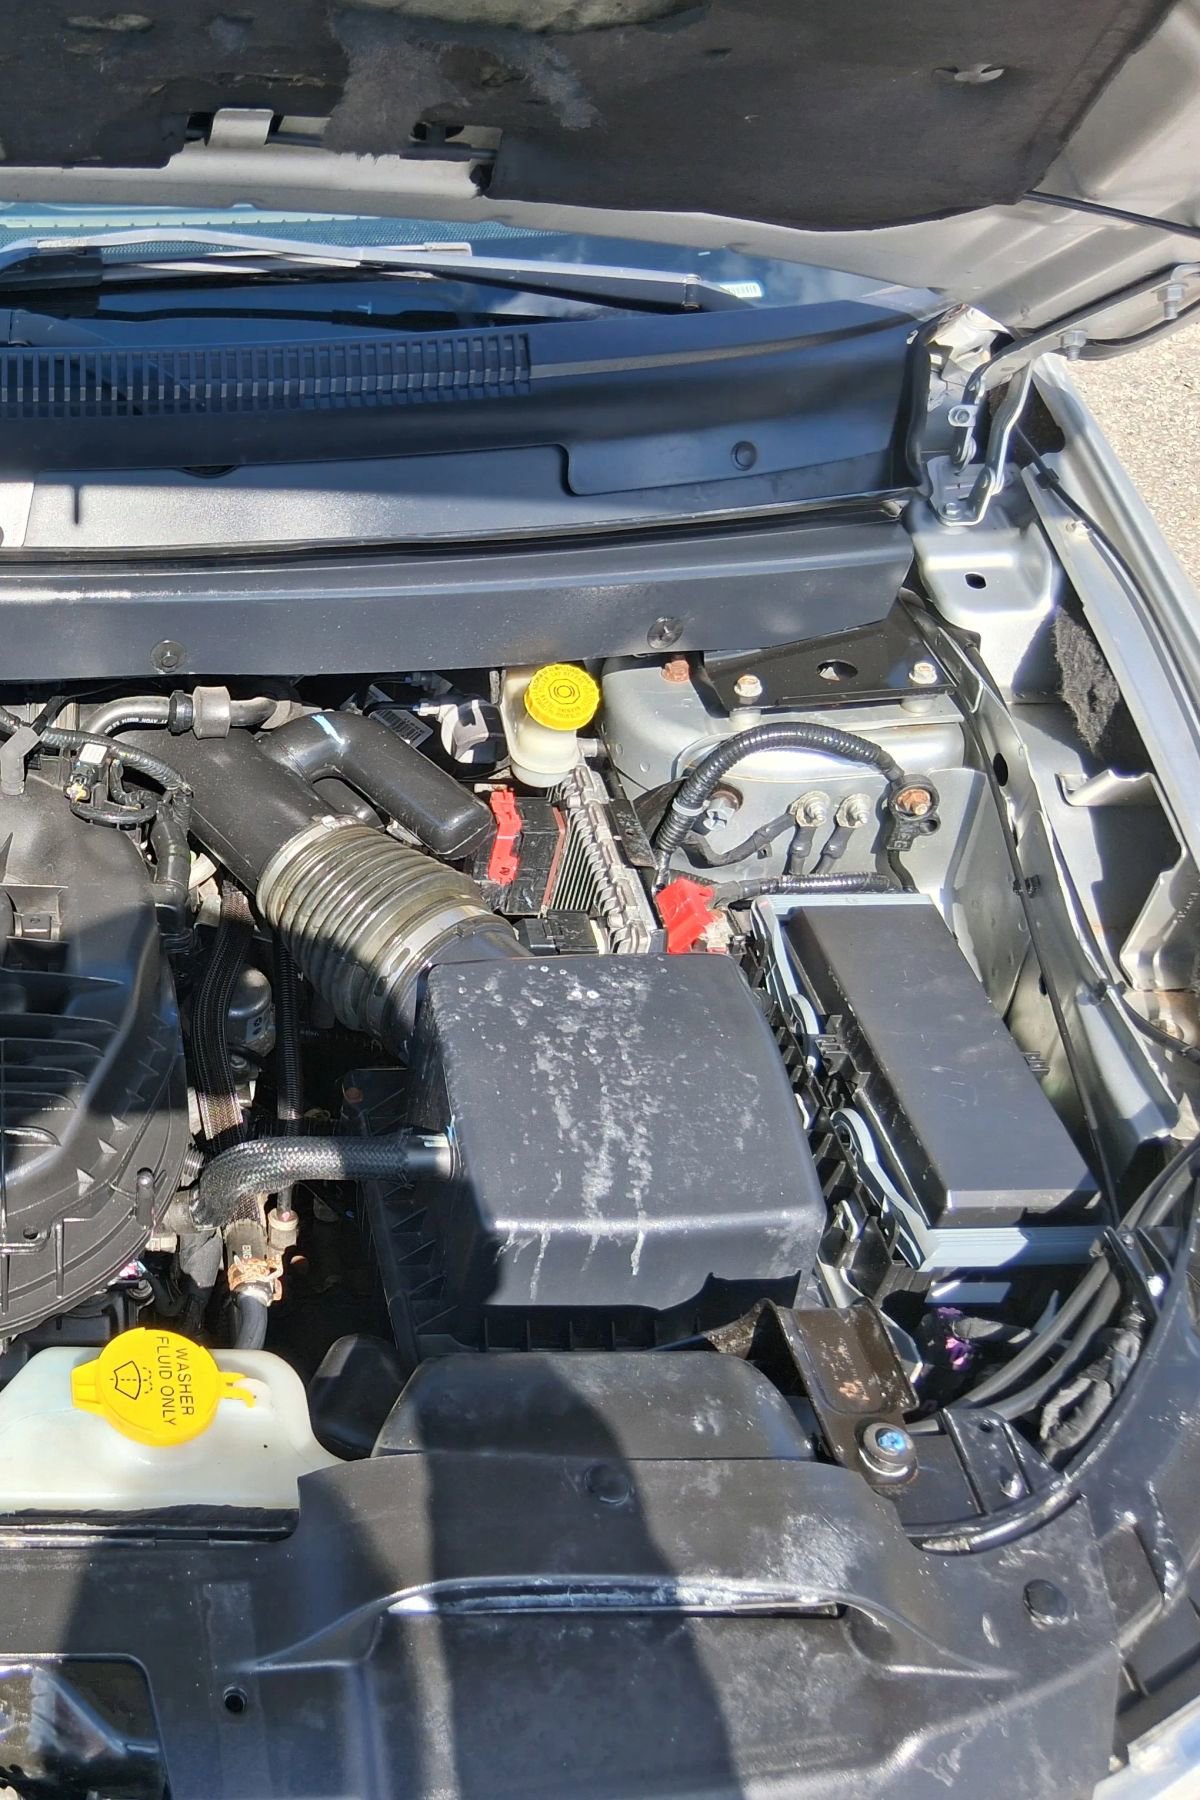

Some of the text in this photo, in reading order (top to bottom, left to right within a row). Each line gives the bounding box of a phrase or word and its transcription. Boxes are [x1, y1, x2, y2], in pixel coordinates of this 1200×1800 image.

[156, 1336, 176, 1426] FLUID ONLY
[176, 1348, 195, 1416] WASHER
